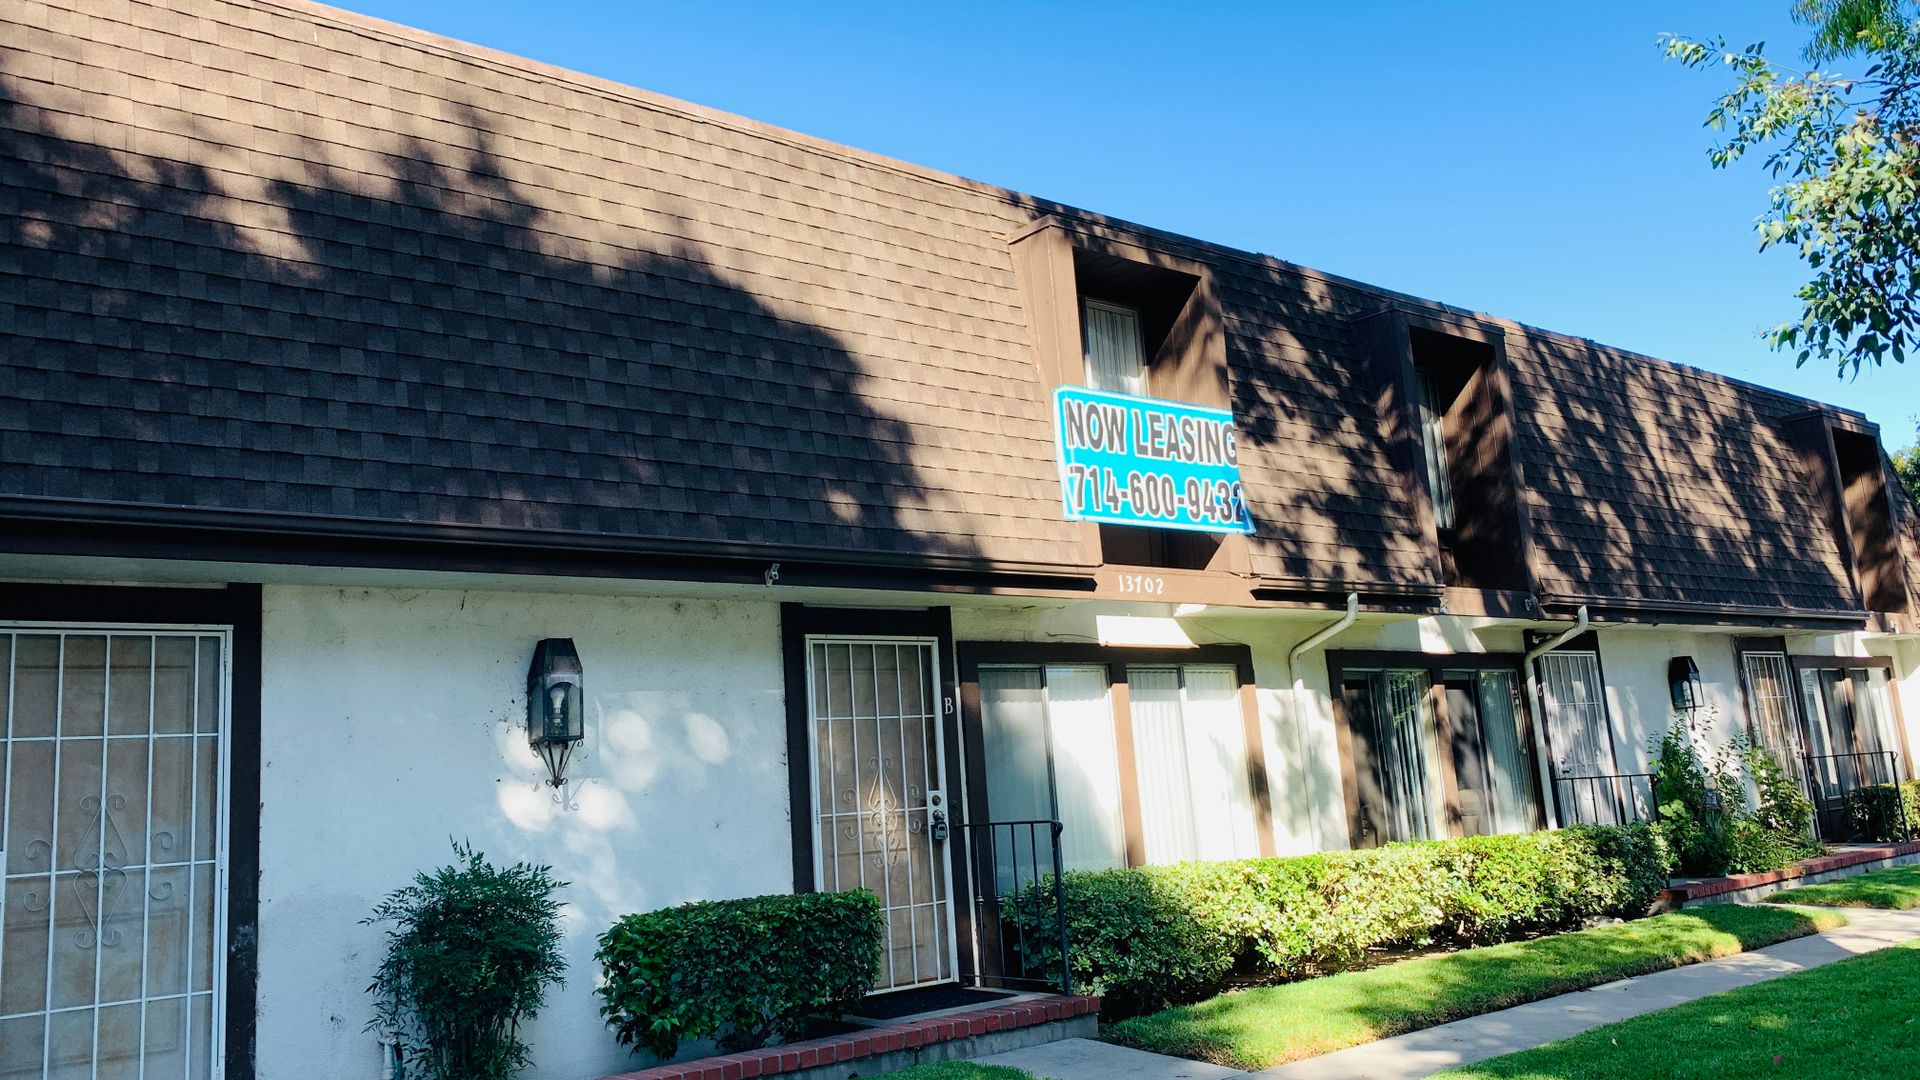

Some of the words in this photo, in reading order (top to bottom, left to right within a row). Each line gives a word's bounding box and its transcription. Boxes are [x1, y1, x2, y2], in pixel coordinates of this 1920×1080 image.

[1064, 399, 1126, 454] NOW
[1131, 409, 1238, 466] LEASING
[1069, 465, 1245, 524] 714-600-9432
[1118, 574, 1164, 595] 13702
[943, 697, 954, 715] B
